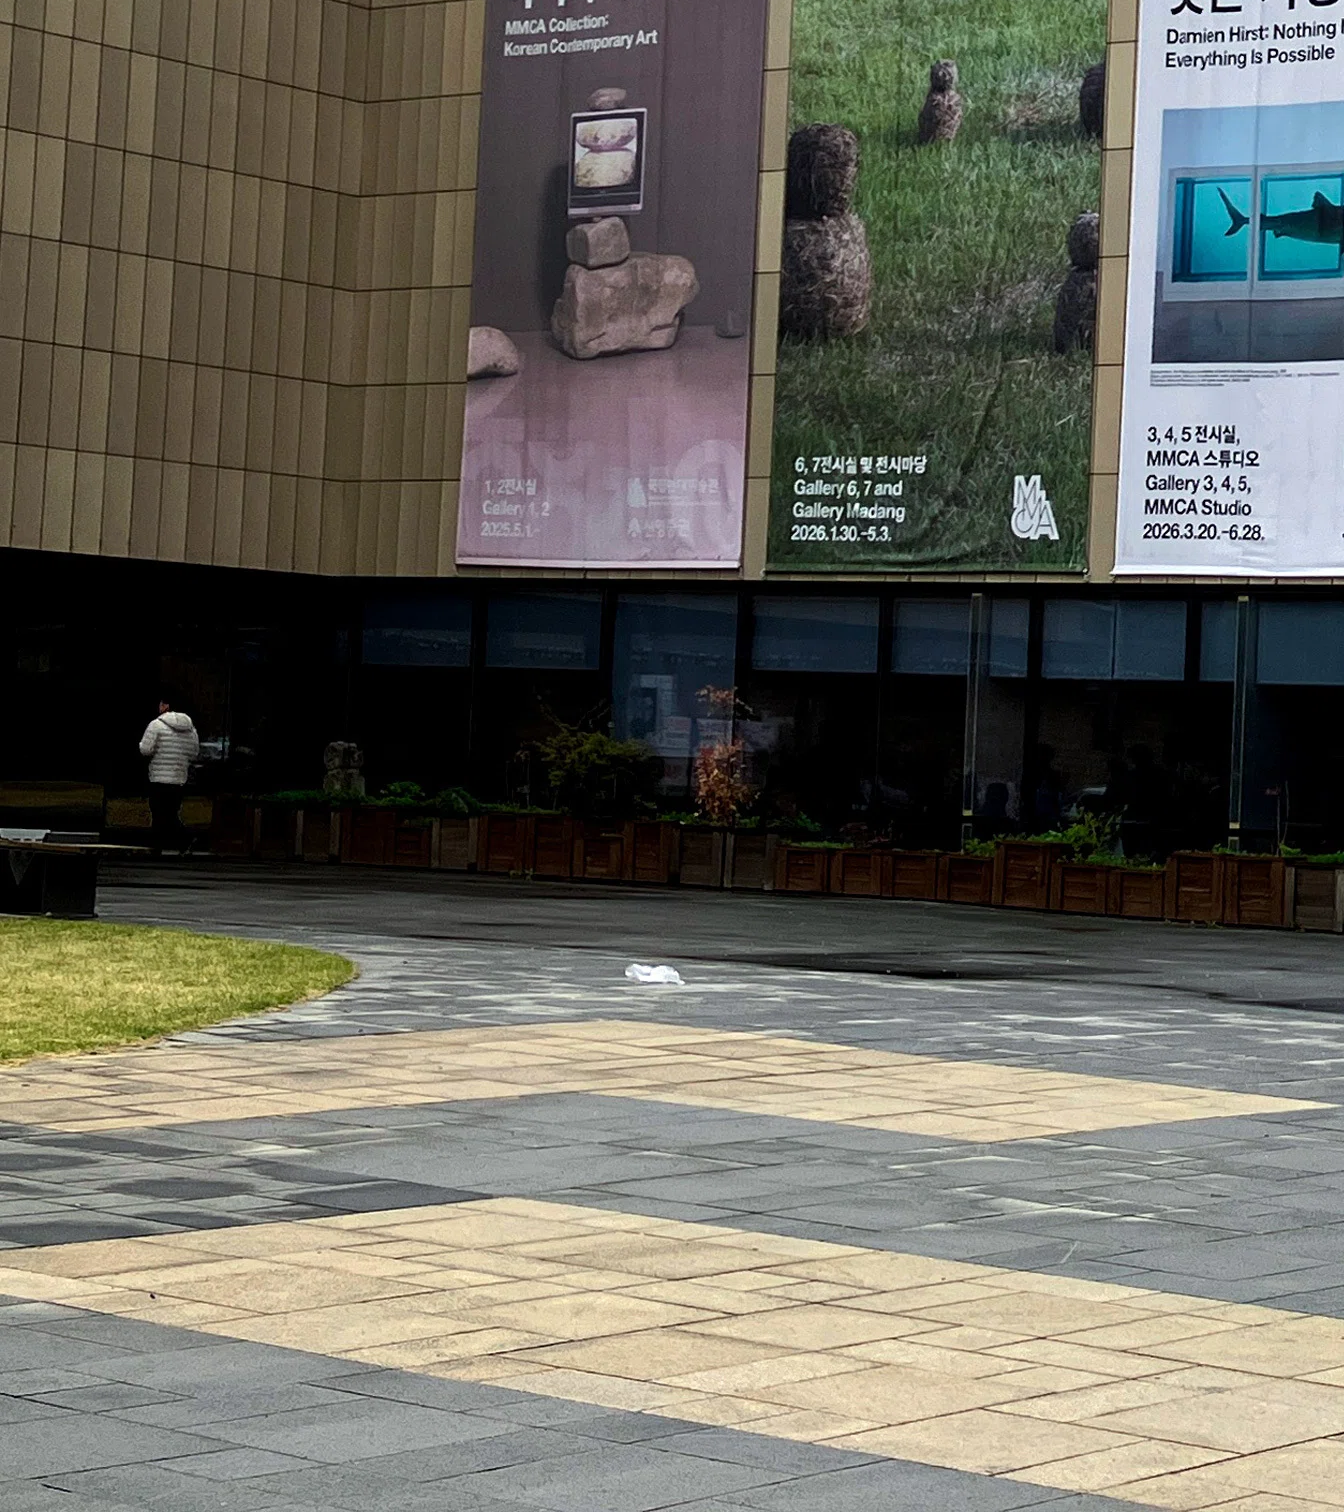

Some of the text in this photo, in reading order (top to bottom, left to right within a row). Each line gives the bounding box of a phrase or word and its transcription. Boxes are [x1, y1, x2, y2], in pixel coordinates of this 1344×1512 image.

[505, 19, 546, 35] MMCA
[1166, 27, 1225, 45] Damien
[1229, 23, 1270, 43] Hirst:
[1273, 19, 1336, 40] Nothing
[504, 40, 547, 56] Korean
[636, 30, 657, 45] Art
[1165, 44, 1335, 70] Everything Is Possible
[1147, 424, 1241, 445] 3, 4, 5 전시실,
[795, 458, 809, 474] 6,
[812, 456, 857, 473] 7전시실
[876, 456, 927, 474] 전시마당
[1146, 450, 1259, 469] MMCA 스튜디오
[794, 480, 902, 499] Gallery 6, 7 and
[1145, 475, 1251, 494] Gallery 3, 4, 5,
[793, 502, 905, 522] Gallery Madang
[1144, 499, 1252, 516] MMCA Studio
